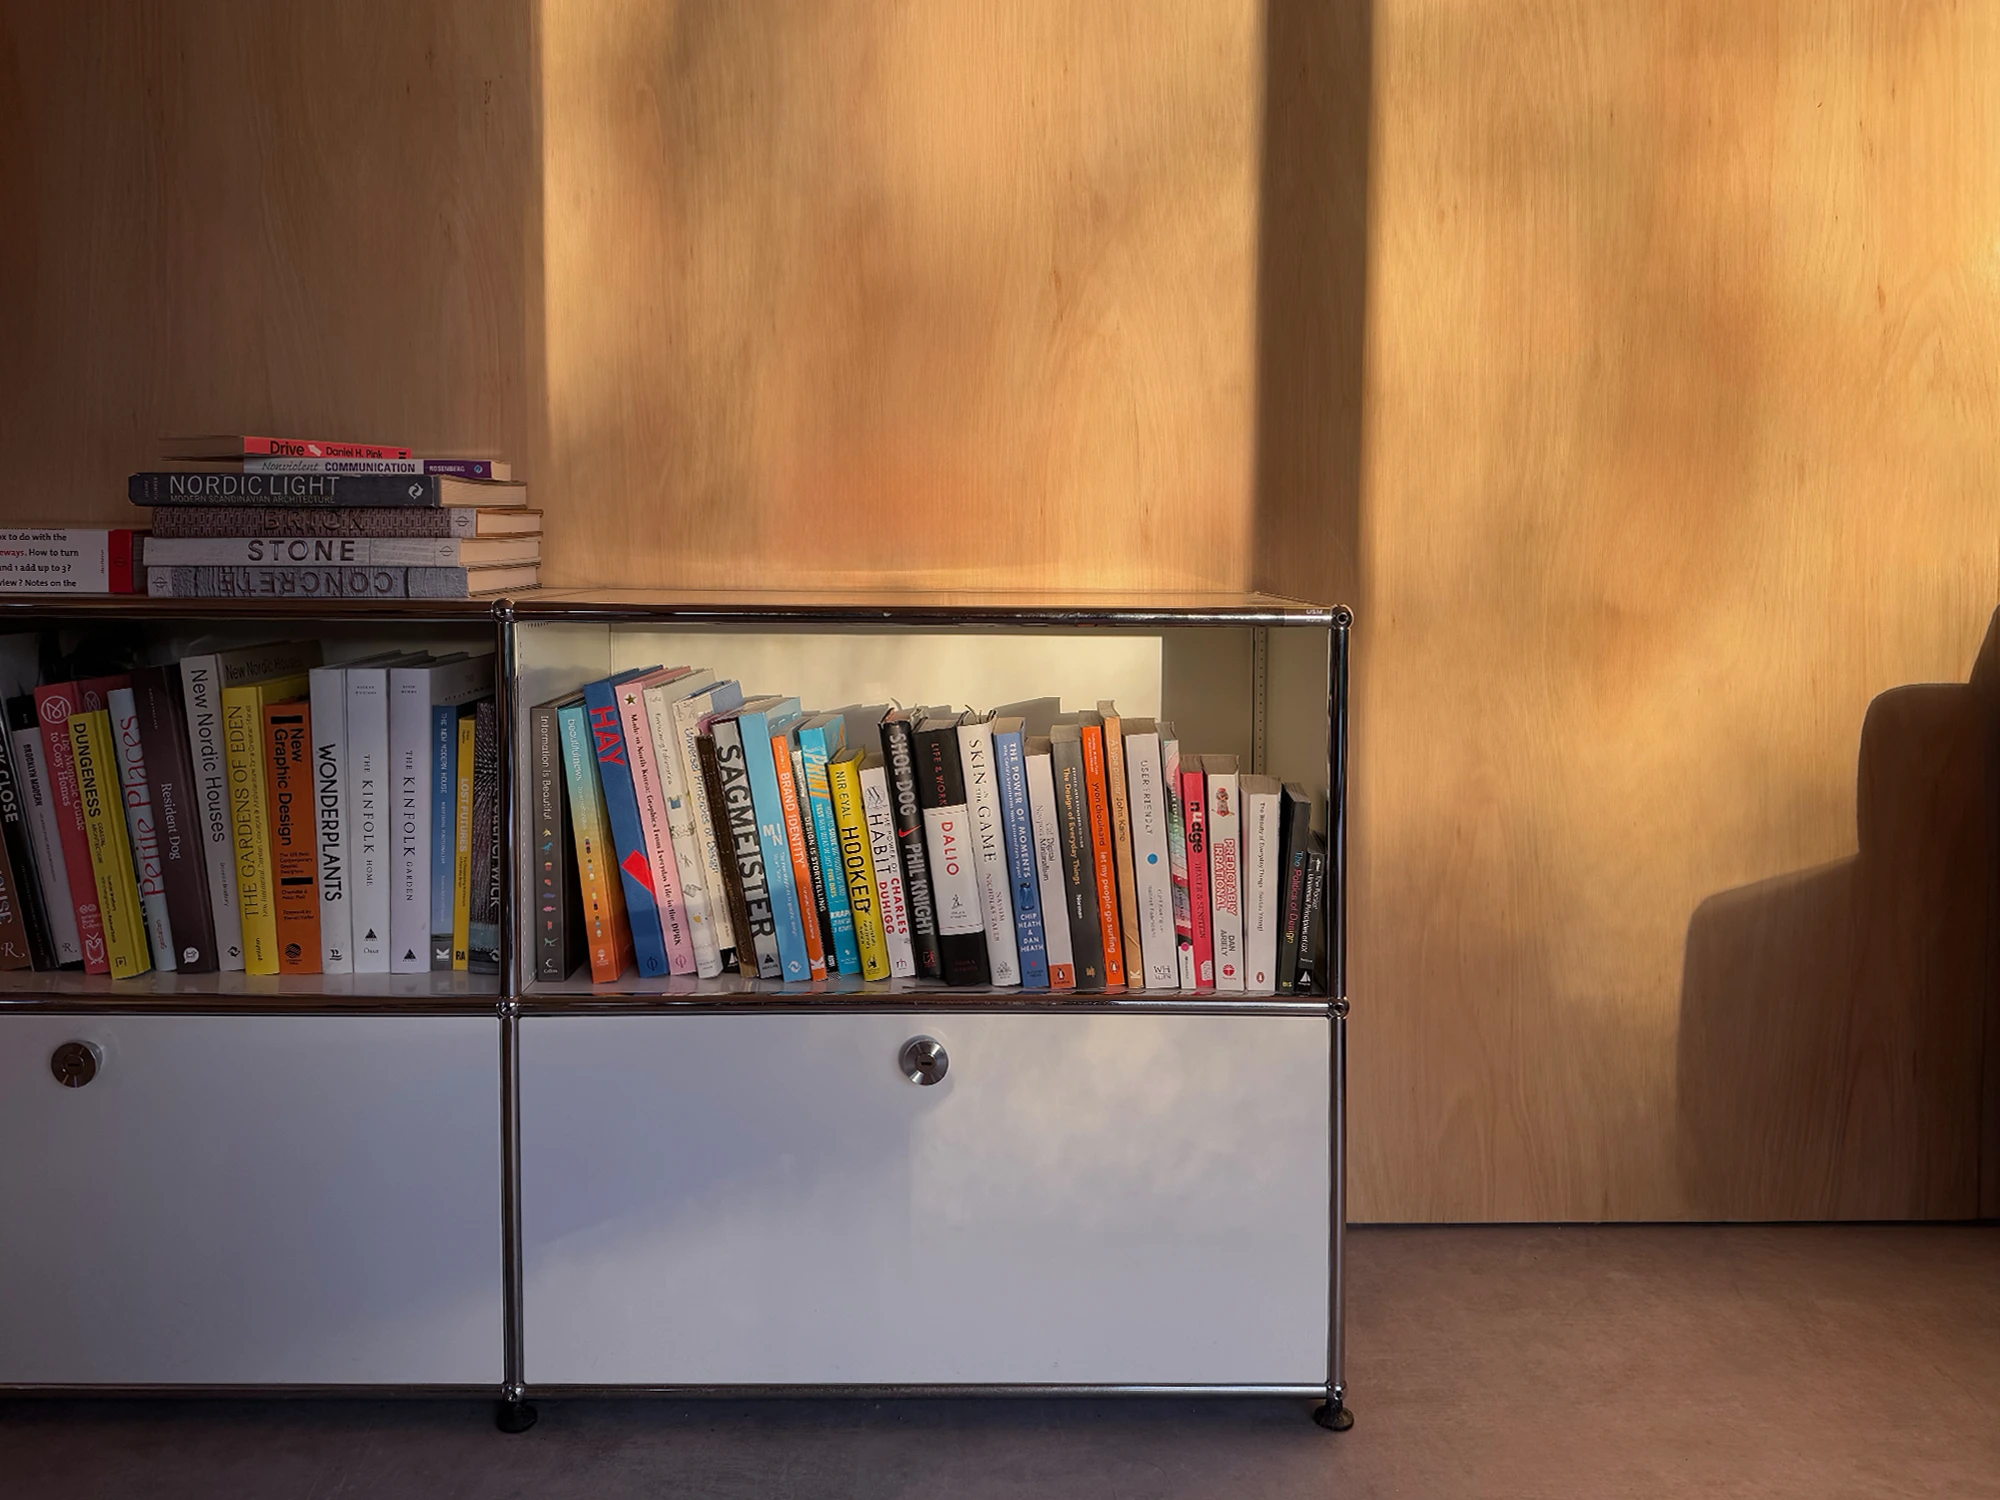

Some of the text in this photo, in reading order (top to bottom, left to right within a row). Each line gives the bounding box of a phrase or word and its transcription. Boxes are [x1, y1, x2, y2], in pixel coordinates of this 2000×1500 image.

[269, 440, 383, 459] Drive Daniel H. Pink
[261, 460, 320, 472] Nonviolent
[324, 461, 415, 473] COMMUNICATION
[169, 475, 262, 495] NORDIC
[269, 475, 340, 496] LIGHT
[273, 496, 336, 504] ARCHITECTURE
[19, 533, 30, 541] do
[32, 533, 52, 541] with
[53, 533, 67, 541] the
[28, 548, 79, 557] How to turn
[247, 539, 355, 562] STONE
[38, 565, 48, 574] up
[61, 564, 71, 574] 3?
[219, 570, 394, 594] CONCRETE
[590, 705, 625, 767] HAY
[631, 713, 640, 735] Made
[191, 669, 226, 842] New Nordic Houses
[290, 728, 304, 763] New
[440, 744, 448, 771] MODERN
[567, 718, 584, 782] beautifulnews
[637, 746, 648, 768] North
[684, 727, 700, 773] Universal
[23, 744, 43, 807] BROOKLYN MODERN
[50, 732, 71, 807] to Cosy Homes
[74, 722, 102, 818] DUNGENESS
[363, 754, 371, 773] THE
[540, 715, 553, 821] Information Beautiful
[802, 744, 833, 801] SPRINT
[931, 742, 948, 807] LIFE WORK
[273, 727, 294, 846] Graphic Design
[440, 772, 448, 794] HOUSE
[641, 769, 652, 794] Korea:
[780, 772, 795, 812] BRAND
[834, 770, 845, 790] NIR
[1091, 782, 1101, 803] yvon
[1111, 748, 1126, 842] type primer John Kane
[227, 705, 260, 920] THE GARDENS OF EDEN
[646, 795, 659, 828] Graphics
[694, 775, 709, 824] Principles
[839, 792, 852, 820] EYAL
[968, 739, 997, 863] SKIN GAME
[1009, 742, 1031, 879] THE POWER OF MOMENTS
[1140, 759, 1154, 836] USER FRIENDLY
[160, 783, 182, 860] Resident Dog
[318, 743, 342, 902] WONDERPLANTS
[361, 779, 374, 854] KINFOLK
[403, 776, 416, 857] KINFOLK
[459, 778, 469, 852] LOST FUTURES
[1035, 805, 1045, 837] Newport
[1096, 804, 1106, 847] chouinard
[1188, 801, 1204, 854] nudge
[1258, 815, 1266, 835] Beauty
[653, 828, 662, 849] From
[703, 827, 712, 837] of
[717, 744, 774, 940] SAGMEISTER
[829, 828, 837, 847] SOLVE
[868, 813, 891, 875] HABIT
[886, 829, 897, 862] POWER
[889, 732, 934, 936] SHOE DOG PHIL KNIGHT
[1063, 768, 1084, 919] The Design of Everyday Things Norman
[706, 840, 720, 875] Design
[804, 816, 826, 912] DESIGN IS STORYTELLING
[816, 803, 837, 899] TEST FIVE DAYS
[940, 821, 960, 876] DALIO
[1046, 837, 1056, 862] Digital
[1257, 842, 1266, 869] Everyday
[656, 850, 668, 883] Everyday
[841, 826, 873, 914] HOOKED
[1100, 865, 1108, 880] my
[1213, 843, 1226, 911] IRRATIONAL
[1223, 838, 1238, 917] PREDICTABLY
[1257, 869, 1265, 888] Things
[663, 884, 672, 898] Life
[666, 899, 674, 908] in
[1102, 879, 1112, 909] people
[1194, 861, 1207, 939] THALER SUNSTEIN
[1285, 850, 1304, 945] The Politics of Design
[1305, 873, 1315, 903] Universal
[1312, 888, 1321, 910] Pocket
[668, 908, 677, 921] the
[879, 881, 895, 935] DUHIGG
[890, 877, 908, 935] CHARLES
[985, 873, 1000, 943] NICHOLAS TALEB
[996, 891, 1005, 923] NASSIM
[1020, 912, 1037, 921] CHIP
[1105, 910, 1113, 923] go
[1302, 903, 1312, 935] Principles
[671, 922, 681, 946] DPRK
[1018, 921, 1042, 929] HEATH
[1022, 937, 1040, 945] DAN
[1107, 924, 1117, 953] surfing
[1302, 935, 1309, 943] of
[1020, 944, 1044, 953] HEATH
[1219, 929, 1229, 957] ARIELY
[1228, 934, 1236, 952] DAN
[1301, 942, 1308, 953] UX
